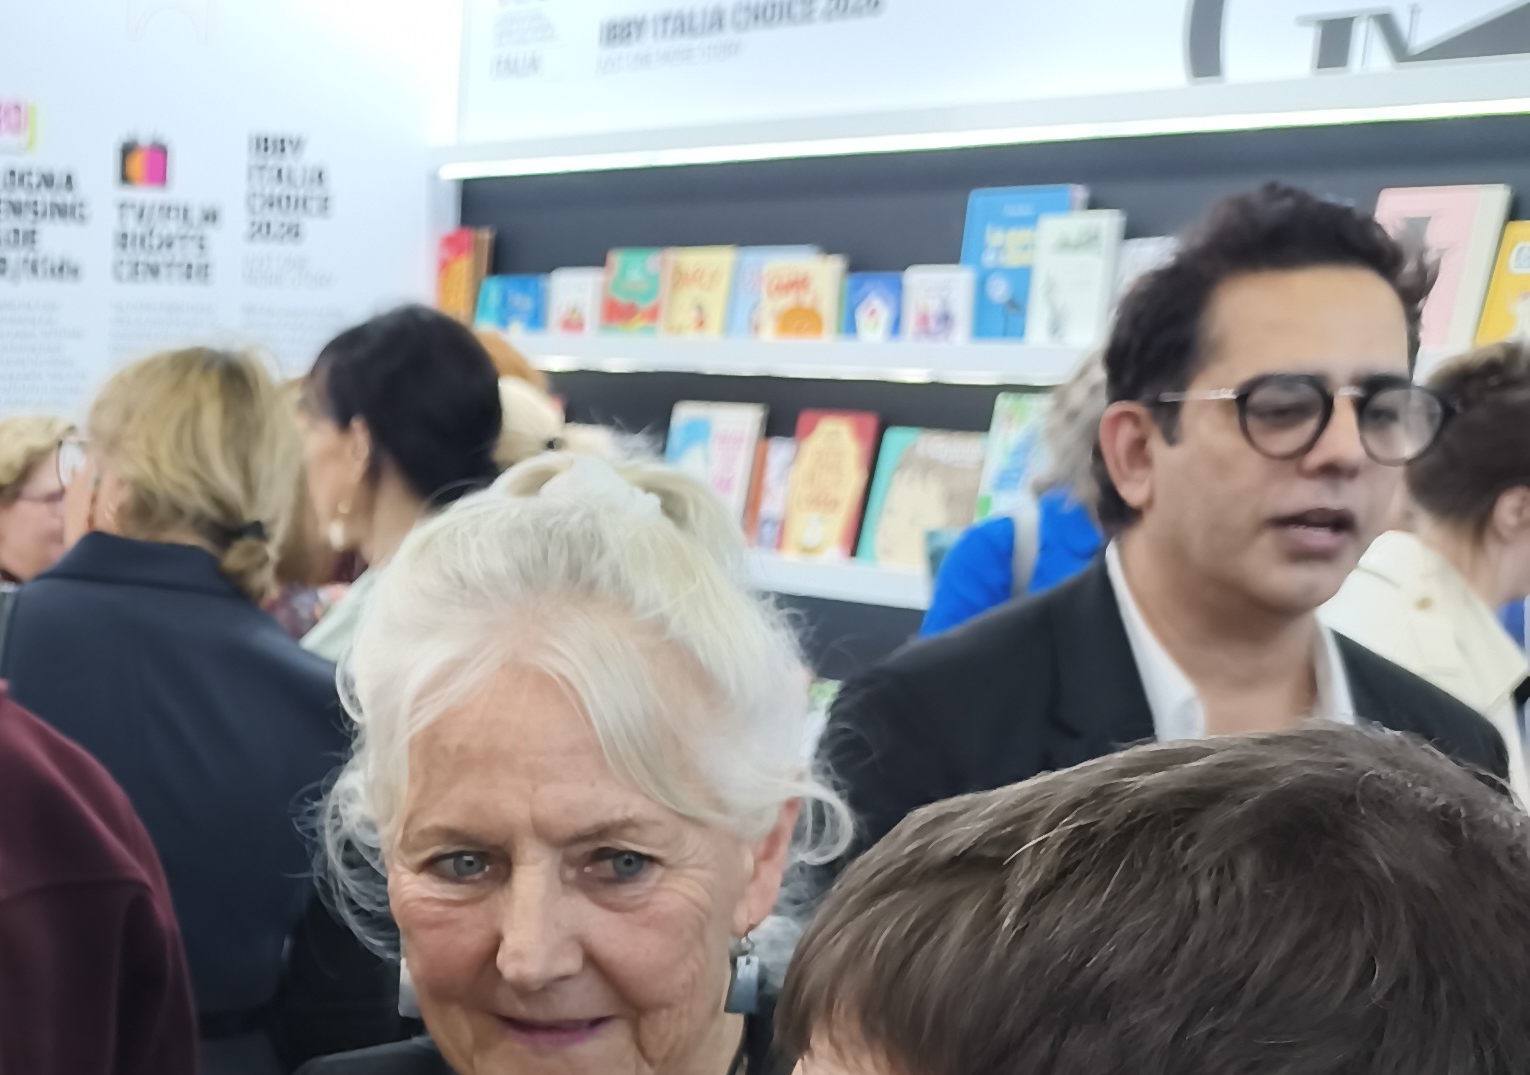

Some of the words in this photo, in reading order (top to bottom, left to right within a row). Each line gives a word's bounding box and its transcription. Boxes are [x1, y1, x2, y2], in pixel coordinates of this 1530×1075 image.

[598, 14, 645, 48] IBBY
[651, 6, 724, 41] ITALIA
[729, 0, 816, 34] CHOICE
[116, 229, 208, 253] RIGHTS
[114, 259, 211, 284] CENTRE
